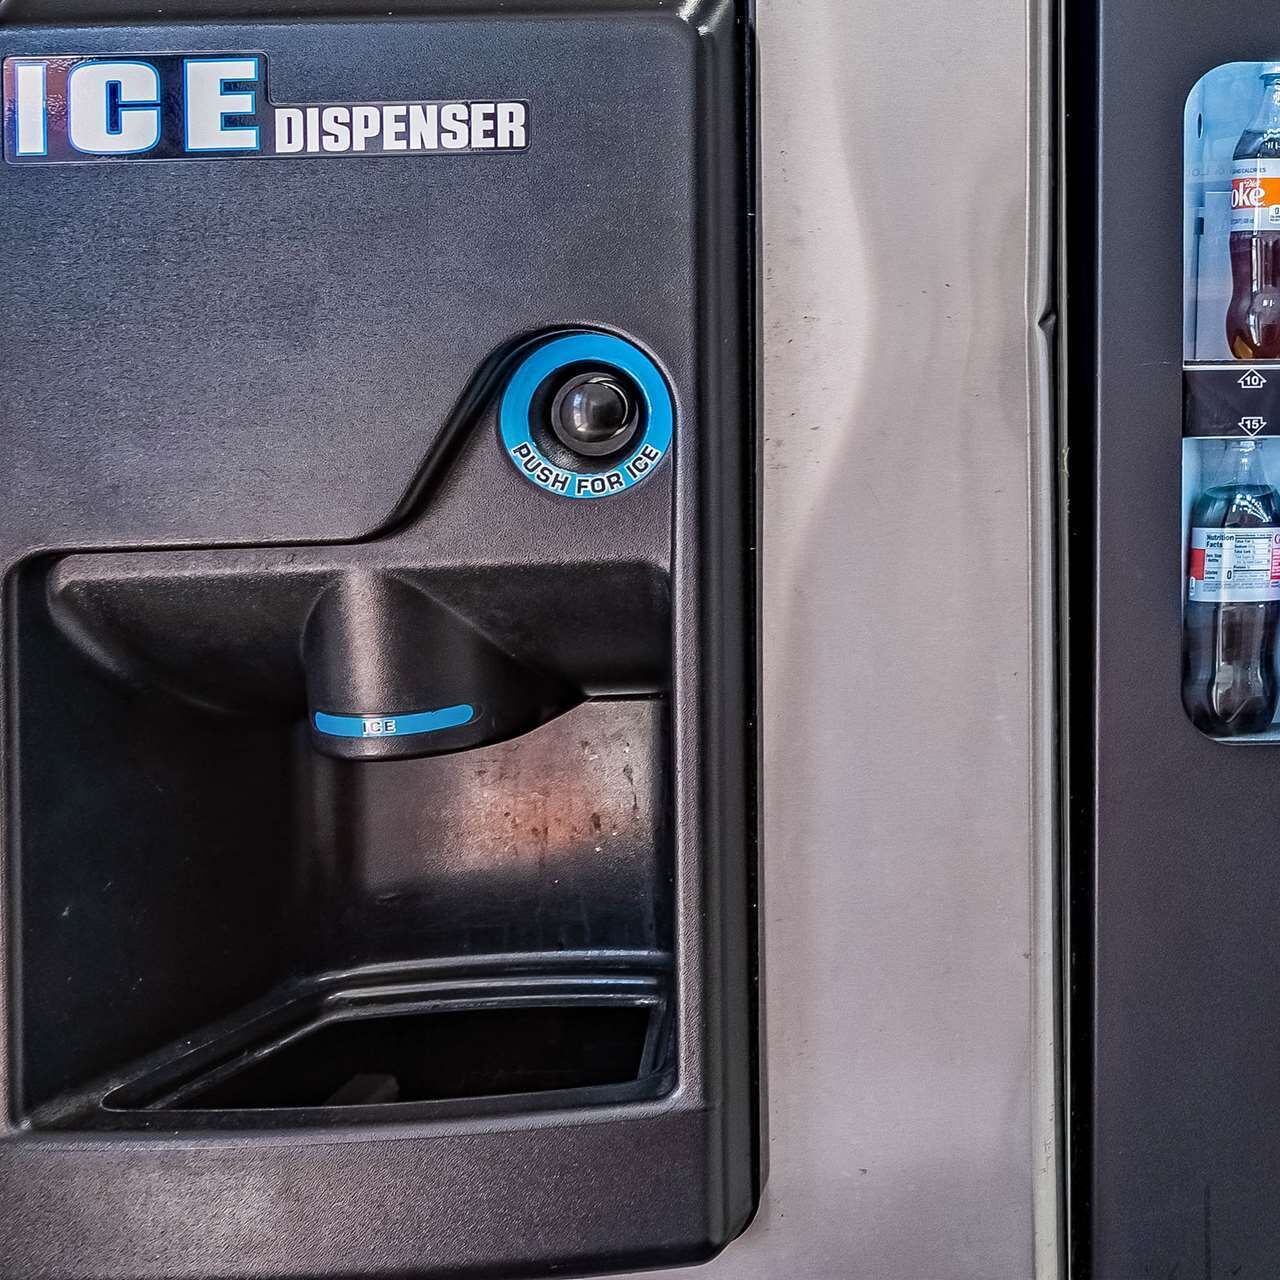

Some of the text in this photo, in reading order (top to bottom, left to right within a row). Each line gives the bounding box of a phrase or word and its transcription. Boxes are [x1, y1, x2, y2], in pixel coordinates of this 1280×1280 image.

[15, 60, 260, 156] ICE
[274, 103, 525, 153] DISPENSER
[1245, 375, 1260, 386] 10
[1245, 418, 1260, 429] 15
[512, 443, 660, 494] PUSH FOR ICE
[362, 720, 396, 733] ICE
